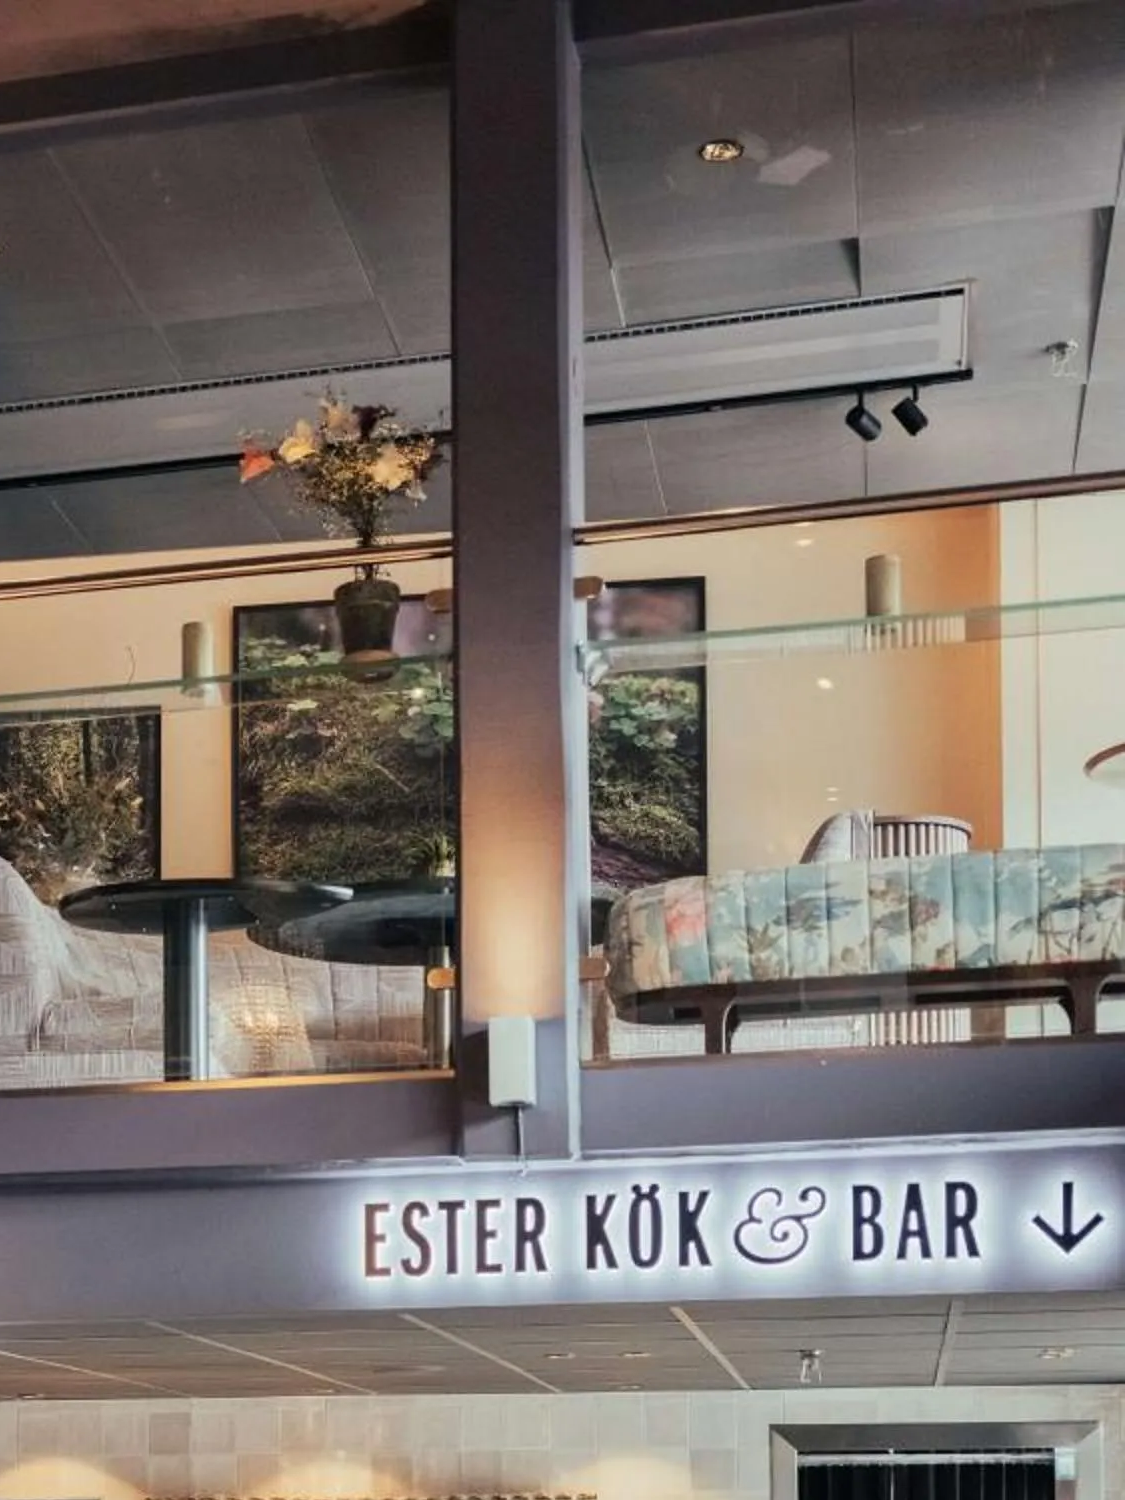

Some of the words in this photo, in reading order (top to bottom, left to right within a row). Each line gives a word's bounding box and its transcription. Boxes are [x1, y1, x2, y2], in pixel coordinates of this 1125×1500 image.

[363, 1197, 548, 1277] ESTER
[584, 1182, 713, 1270] KÖK
[732, 1185, 827, 1266] &
[850, 1181, 981, 1262] BAR
